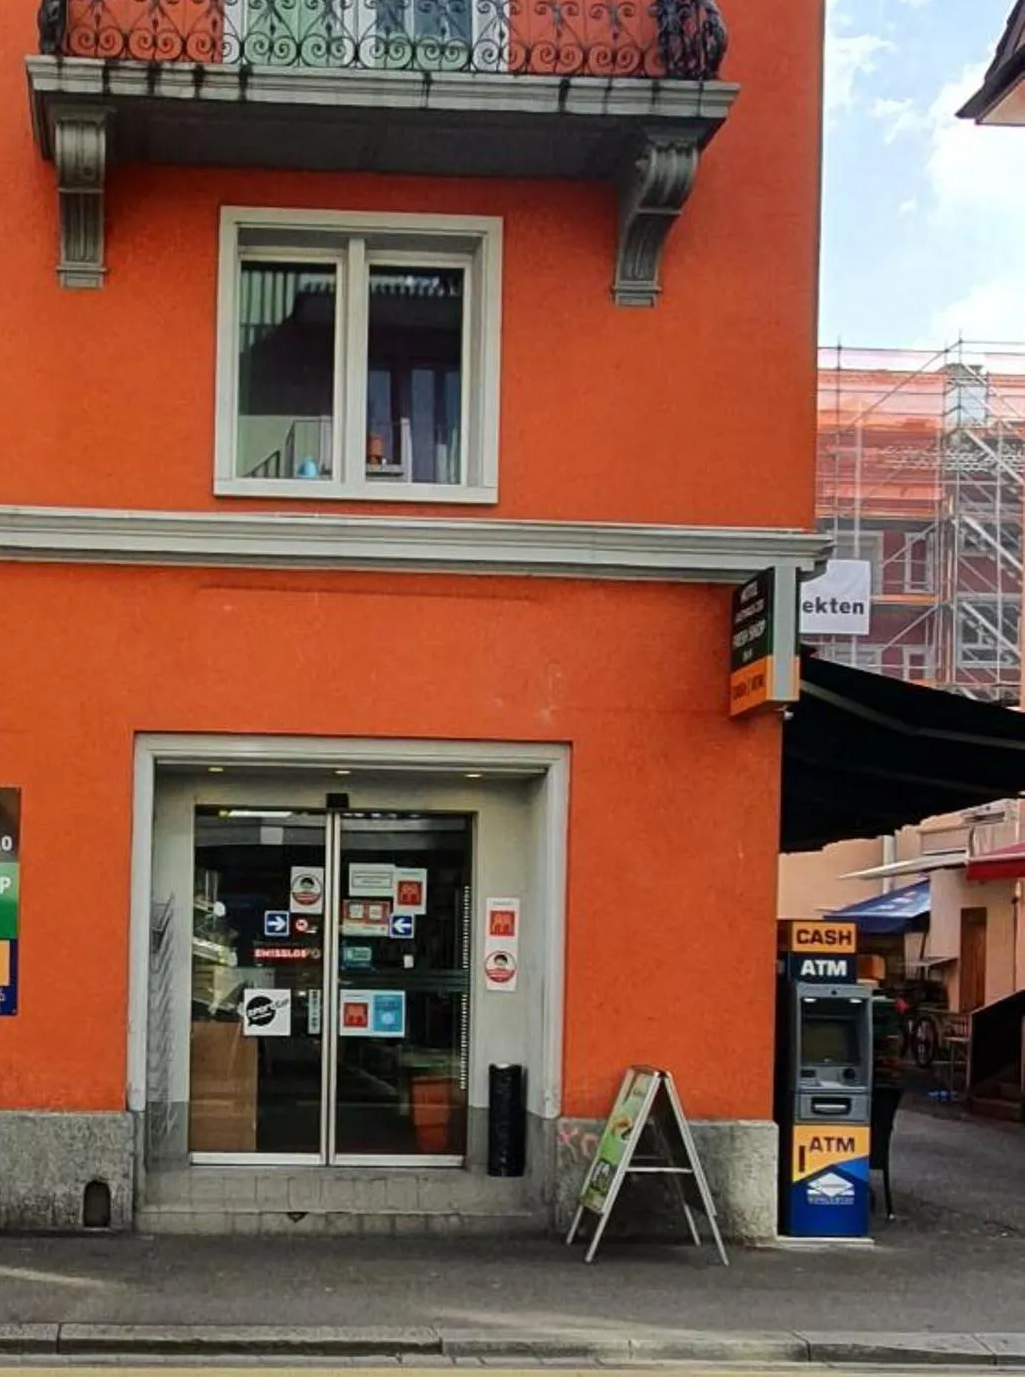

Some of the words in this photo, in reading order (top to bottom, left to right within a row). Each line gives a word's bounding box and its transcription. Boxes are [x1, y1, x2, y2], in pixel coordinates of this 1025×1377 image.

[802, 596, 865, 615] ekten
[796, 929, 852, 946] CASH
[800, 959, 848, 976] ATM
[809, 1136, 855, 1153] ATM
